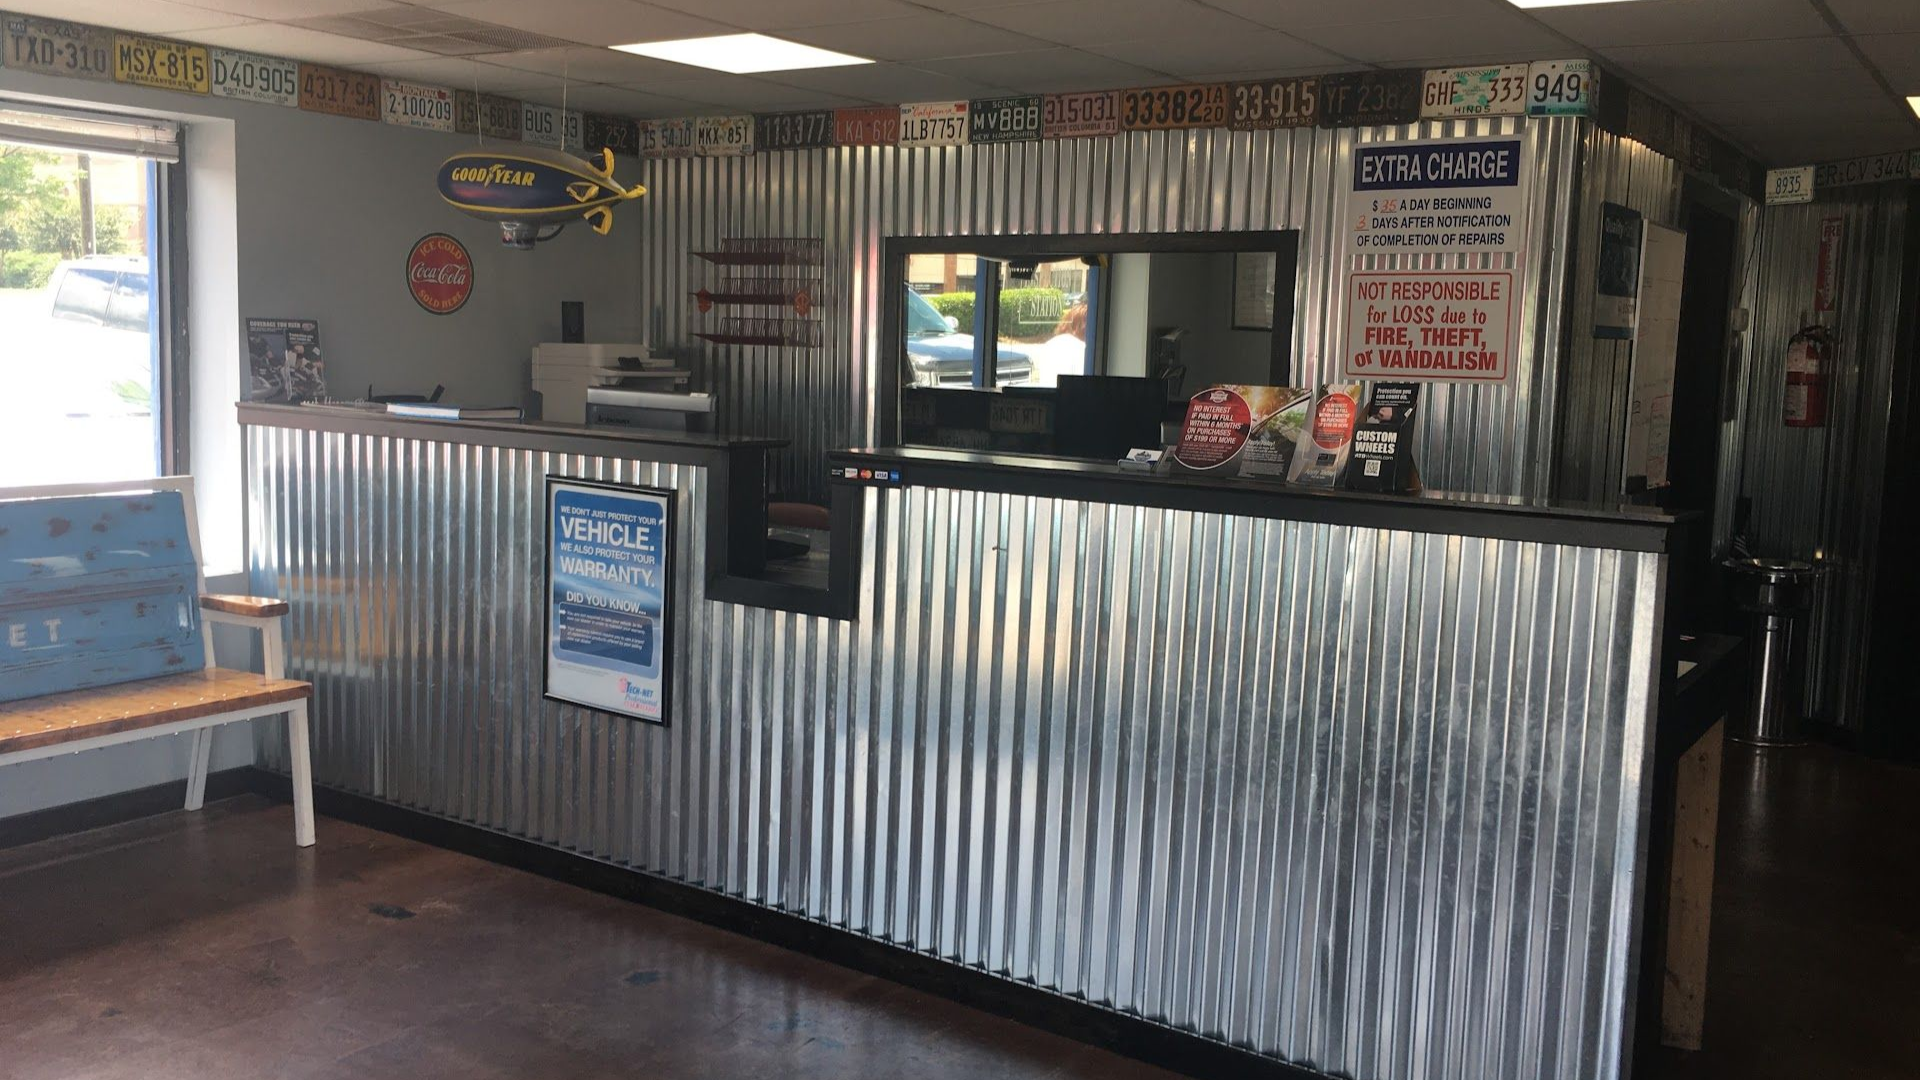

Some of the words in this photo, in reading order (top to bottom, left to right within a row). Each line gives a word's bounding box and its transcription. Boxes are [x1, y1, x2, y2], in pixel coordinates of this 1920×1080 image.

[119, 44, 204, 82] MSX-815
[1487, 76, 1525, 104] 333
[1534, 73, 1581, 104] 949
[992, 99, 1020, 109] SCENIC
[1124, 88, 1204, 127] 33382
[1205, 86, 1224, 105] IA
[1453, 105, 1492, 115] HINDS
[525, 108, 552, 134] BUS
[1203, 105, 1224, 123] 20
[901, 116, 965, 142] 1LB7757
[1068, 123, 1101, 132] COLUMBIA
[1233, 119, 1283, 130] MISSOURI
[698, 126, 719, 146] MKX
[727, 126, 748, 144] 851
[972, 132, 990, 142] NEW
[992, 130, 1038, 141] HAMPSHIRE
[451, 163, 536, 189] GOODYEAR
[1361, 153, 1422, 184] EXTRA
[1427, 149, 1510, 182] CHARGE
[1775, 175, 1801, 195] 8935
[1372, 199, 1379, 213] $
[1399, 198, 1407, 211] A
[1409, 197, 1431, 211] DAY
[1432, 196, 1492, 211] BEGINNING
[1371, 216, 1399, 230] DAYS
[1400, 215, 1434, 229] AFTER
[1436, 213, 1511, 228] NOTIFICATION
[1356, 234, 1370, 247] OF
[1371, 233, 1439, 247] COMPLETION
[1441, 232, 1456, 246] OF
[1458, 231, 1505, 246] REPAIRS
[420, 241, 435, 257] ICE
[437, 240, 463, 259] COLD
[418, 289, 440, 308] SOLD
[441, 291, 463, 308] HERE
[1357, 281, 1388, 301] NOT
[1391, 281, 1501, 301] RESPONSIBLE
[1367, 304, 1387, 324] for
[1392, 305, 1435, 325] LOSS
[1440, 305, 1466, 324] due
[1472, 307, 1487, 325] to
[1365, 326, 1413, 349] FIRE,
[1420, 327, 1487, 351] THEFT,
[1354, 349, 1373, 368] or
[1378, 350, 1498, 372] VANDALISM
[1193, 404, 1203, 412] NO
[1203, 405, 1232, 414] INTEREST
[1198, 412, 1212, 420] PAID
[1212, 413, 1219, 421] IN
[1219, 413, 1234, 422] FULL
[1186, 427, 1196, 435] ON
[1196, 428, 1232, 437] PURCHASES
[1189, 419, 1211, 428] WITHIN
[1184, 434, 1193, 442] OF
[1208, 435, 1219, 444] OR
[1218, 436, 1237, 445] MORE
[1355, 429, 1398, 444] CUSTOM
[1354, 441, 1396, 455] WHEELS
[560, 505, 571, 514] WE
[571, 506, 591, 517] DON'T
[590, 510, 607, 519] JUST
[607, 511, 637, 523] PROTECT
[637, 515, 657, 526] YOUR
[560, 515, 655, 552] VEHICLE.
[560, 542, 573, 552] WE
[573, 543, 594, 556] ALSO
[595, 547, 631, 561] PROTECT
[632, 552, 655, 565] YOUR
[559, 555, 656, 588] WARRANTY.
[566, 590, 584, 603] DID
[585, 593, 607, 608] YOU
